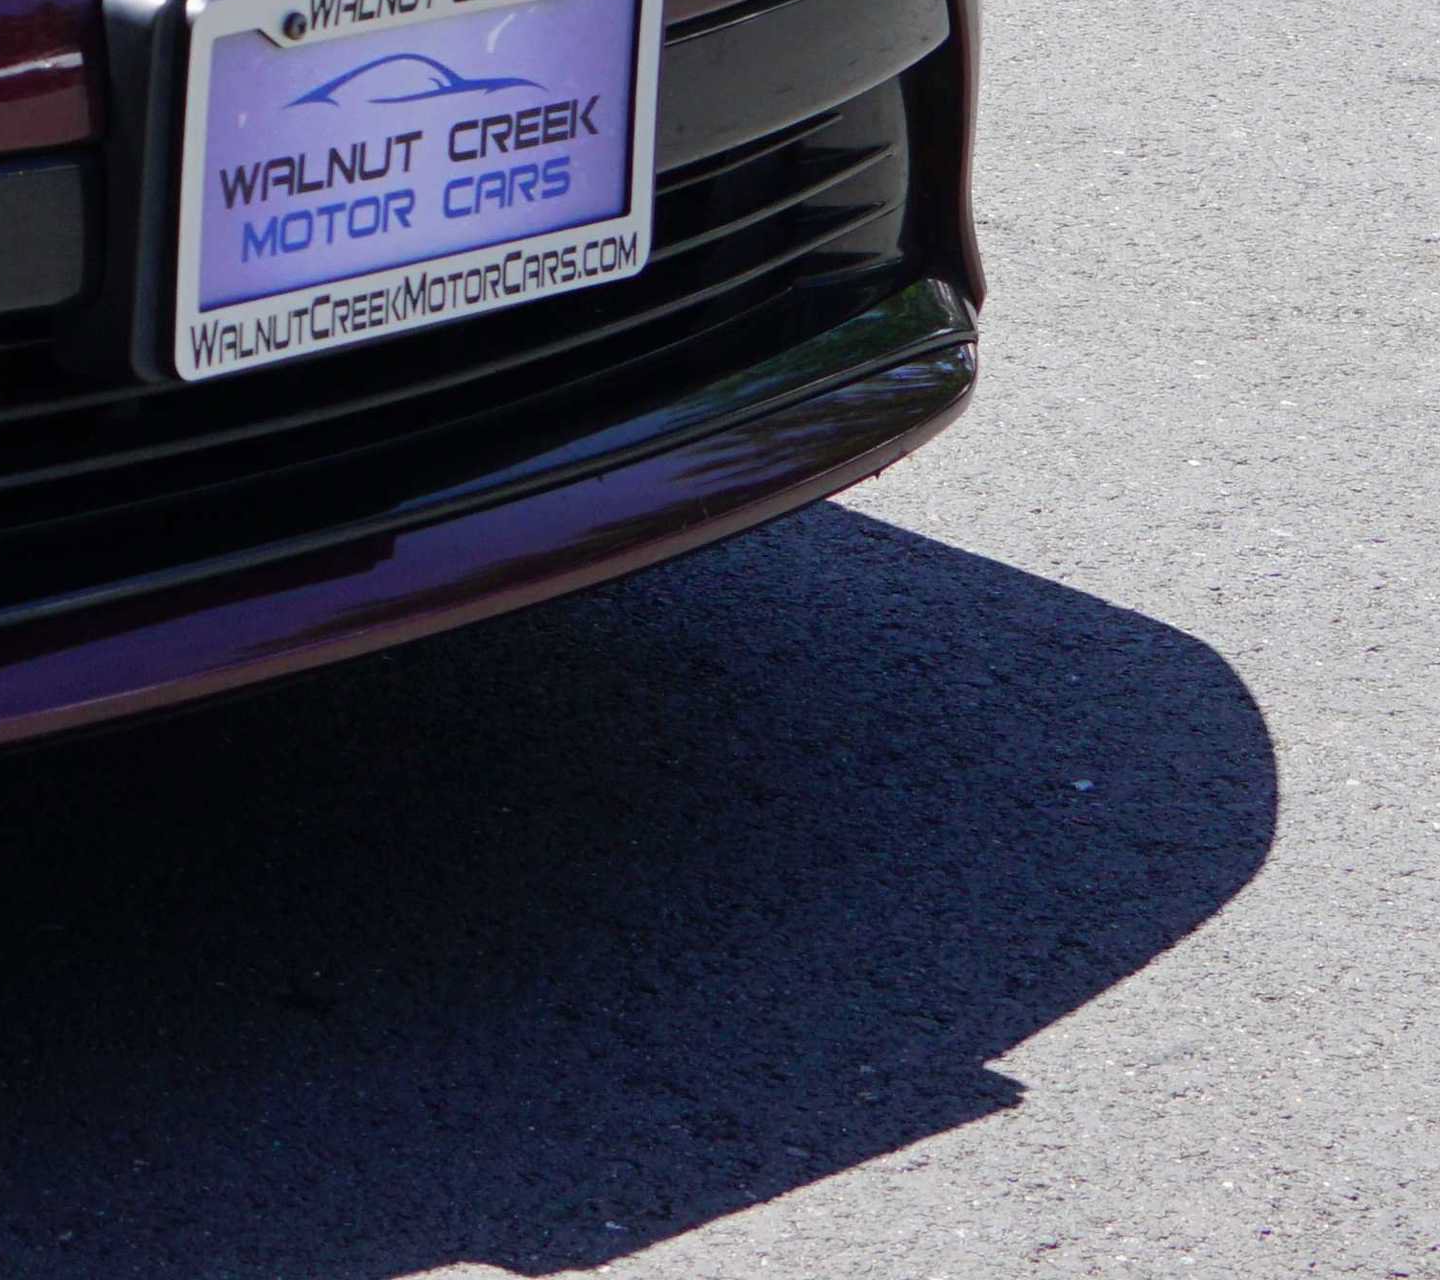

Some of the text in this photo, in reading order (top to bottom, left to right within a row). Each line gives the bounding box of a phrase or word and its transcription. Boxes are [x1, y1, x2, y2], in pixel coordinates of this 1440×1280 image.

[220, 95, 601, 210] WALNUT CREEK
[240, 156, 572, 263] MOTOR CARS
